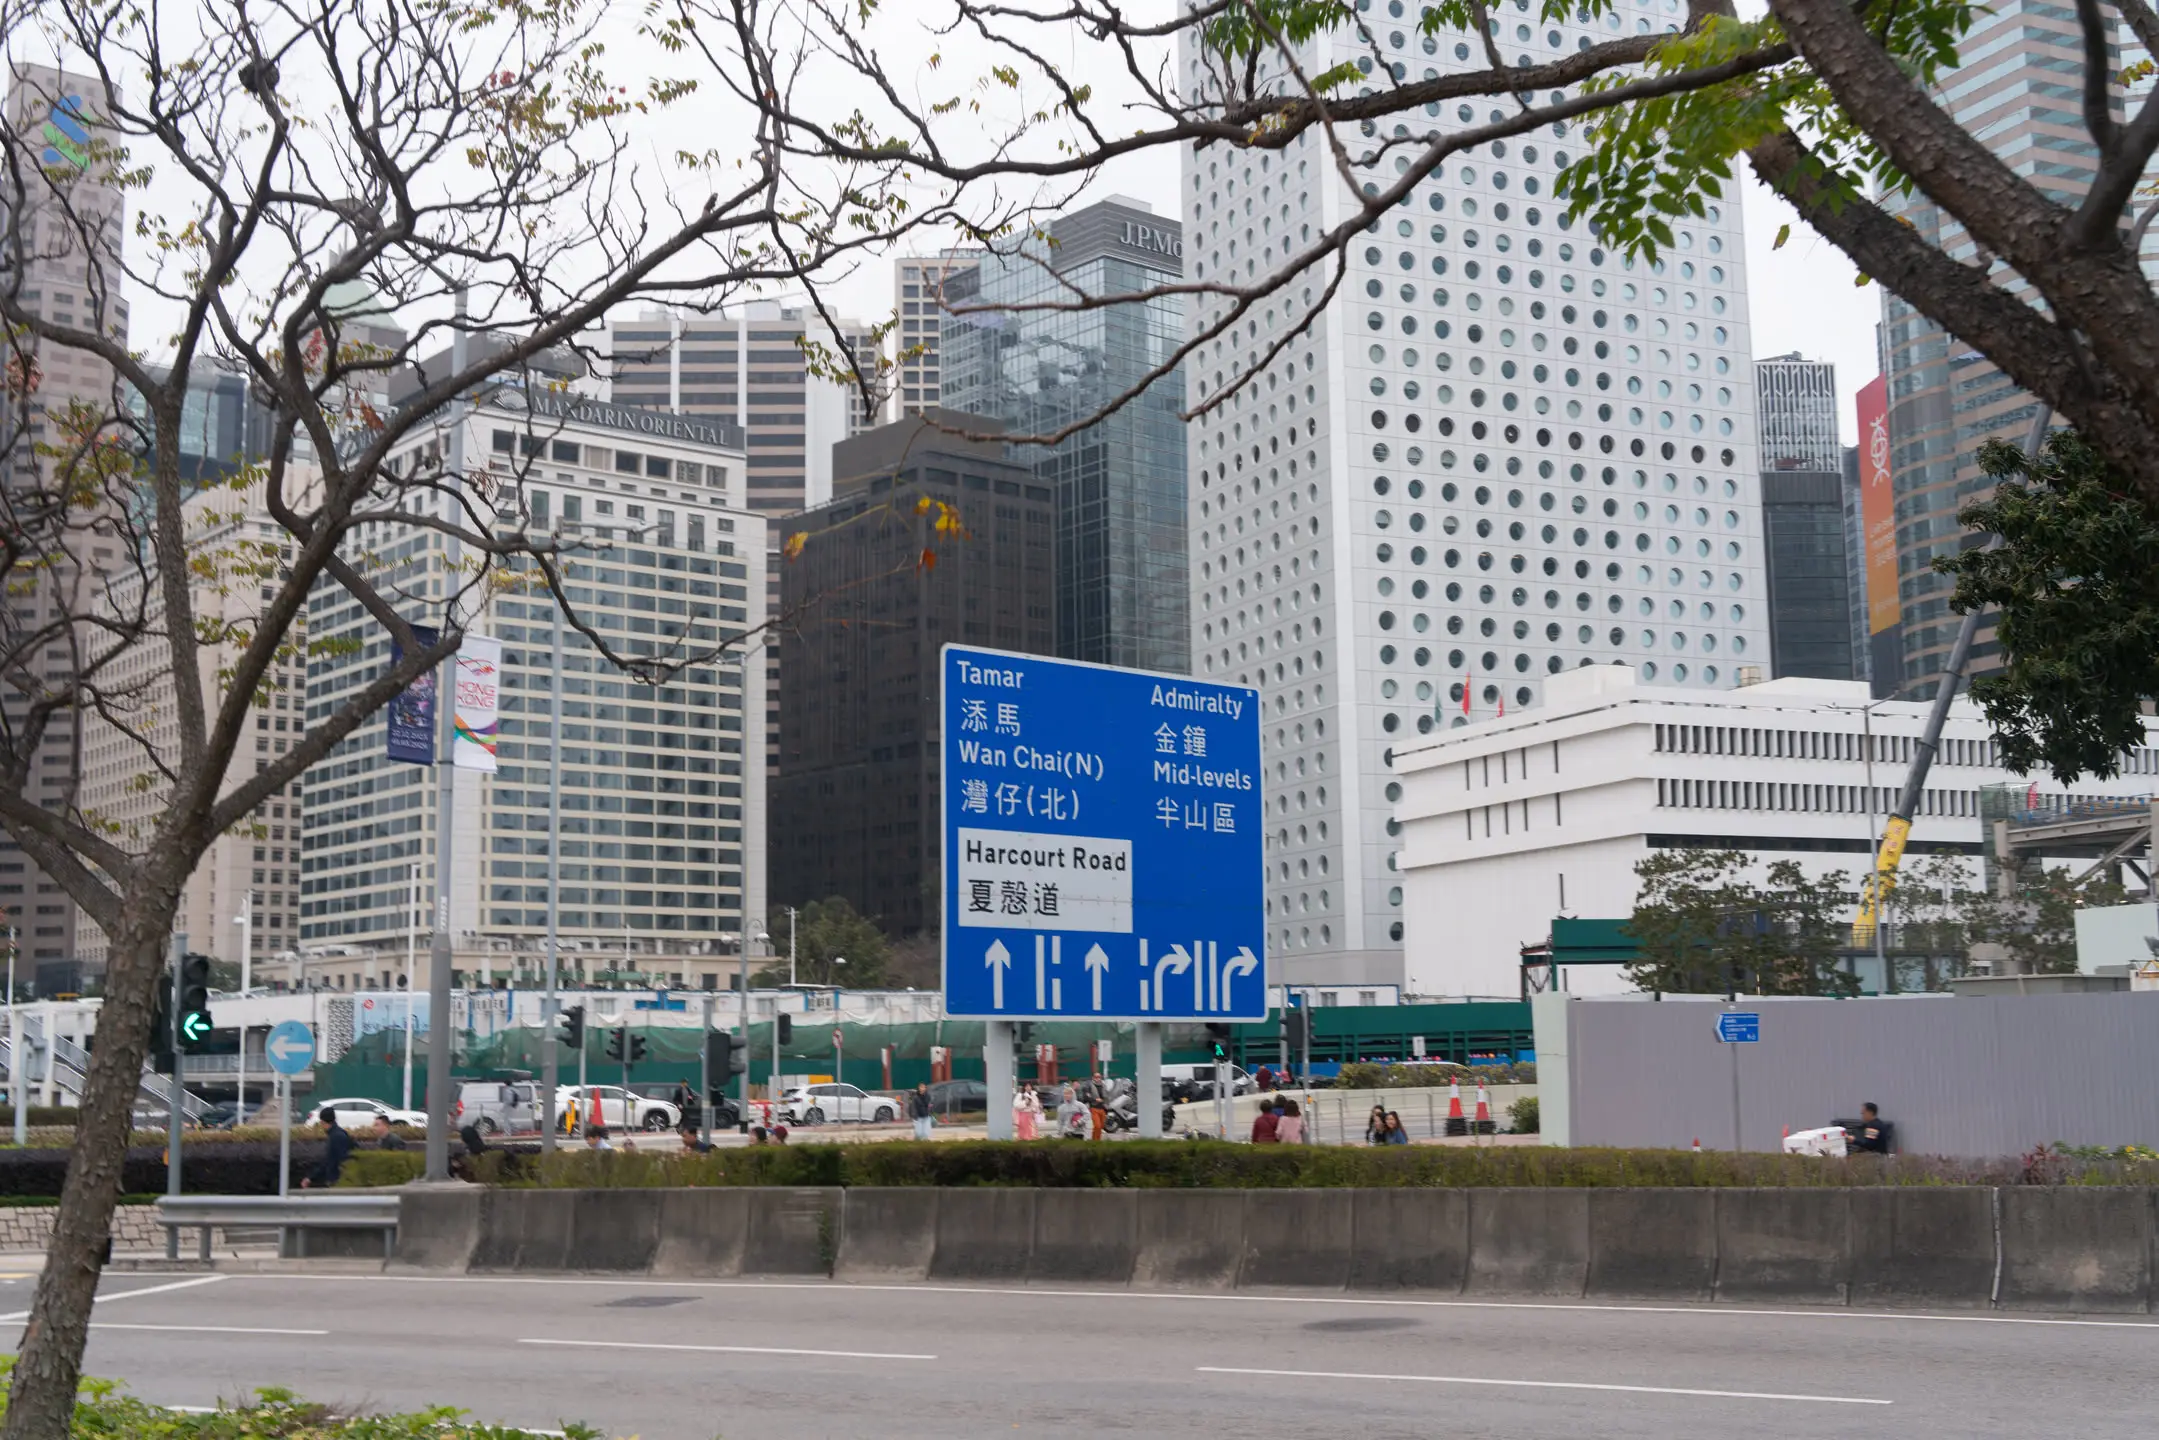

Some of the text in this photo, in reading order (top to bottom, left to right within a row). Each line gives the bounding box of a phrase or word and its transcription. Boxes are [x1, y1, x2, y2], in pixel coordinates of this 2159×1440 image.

[534, 396, 728, 446] MANDARIN ORIENTAL
[457, 680, 496, 697] HONG
[957, 661, 1024, 689] Tamar
[962, 699, 1020, 736] 添馬
[1151, 685, 1243, 720] Admiralty
[1154, 722, 1207, 757] 金鐘
[958, 740, 1104, 781] Wan Chai(N)
[1154, 761, 1252, 790] Mid-levels
[961, 779, 1079, 820] 灣仔(北)
[1155, 797, 1236, 833] 半山區
[966, 840, 1126, 872] Harcourt Road
